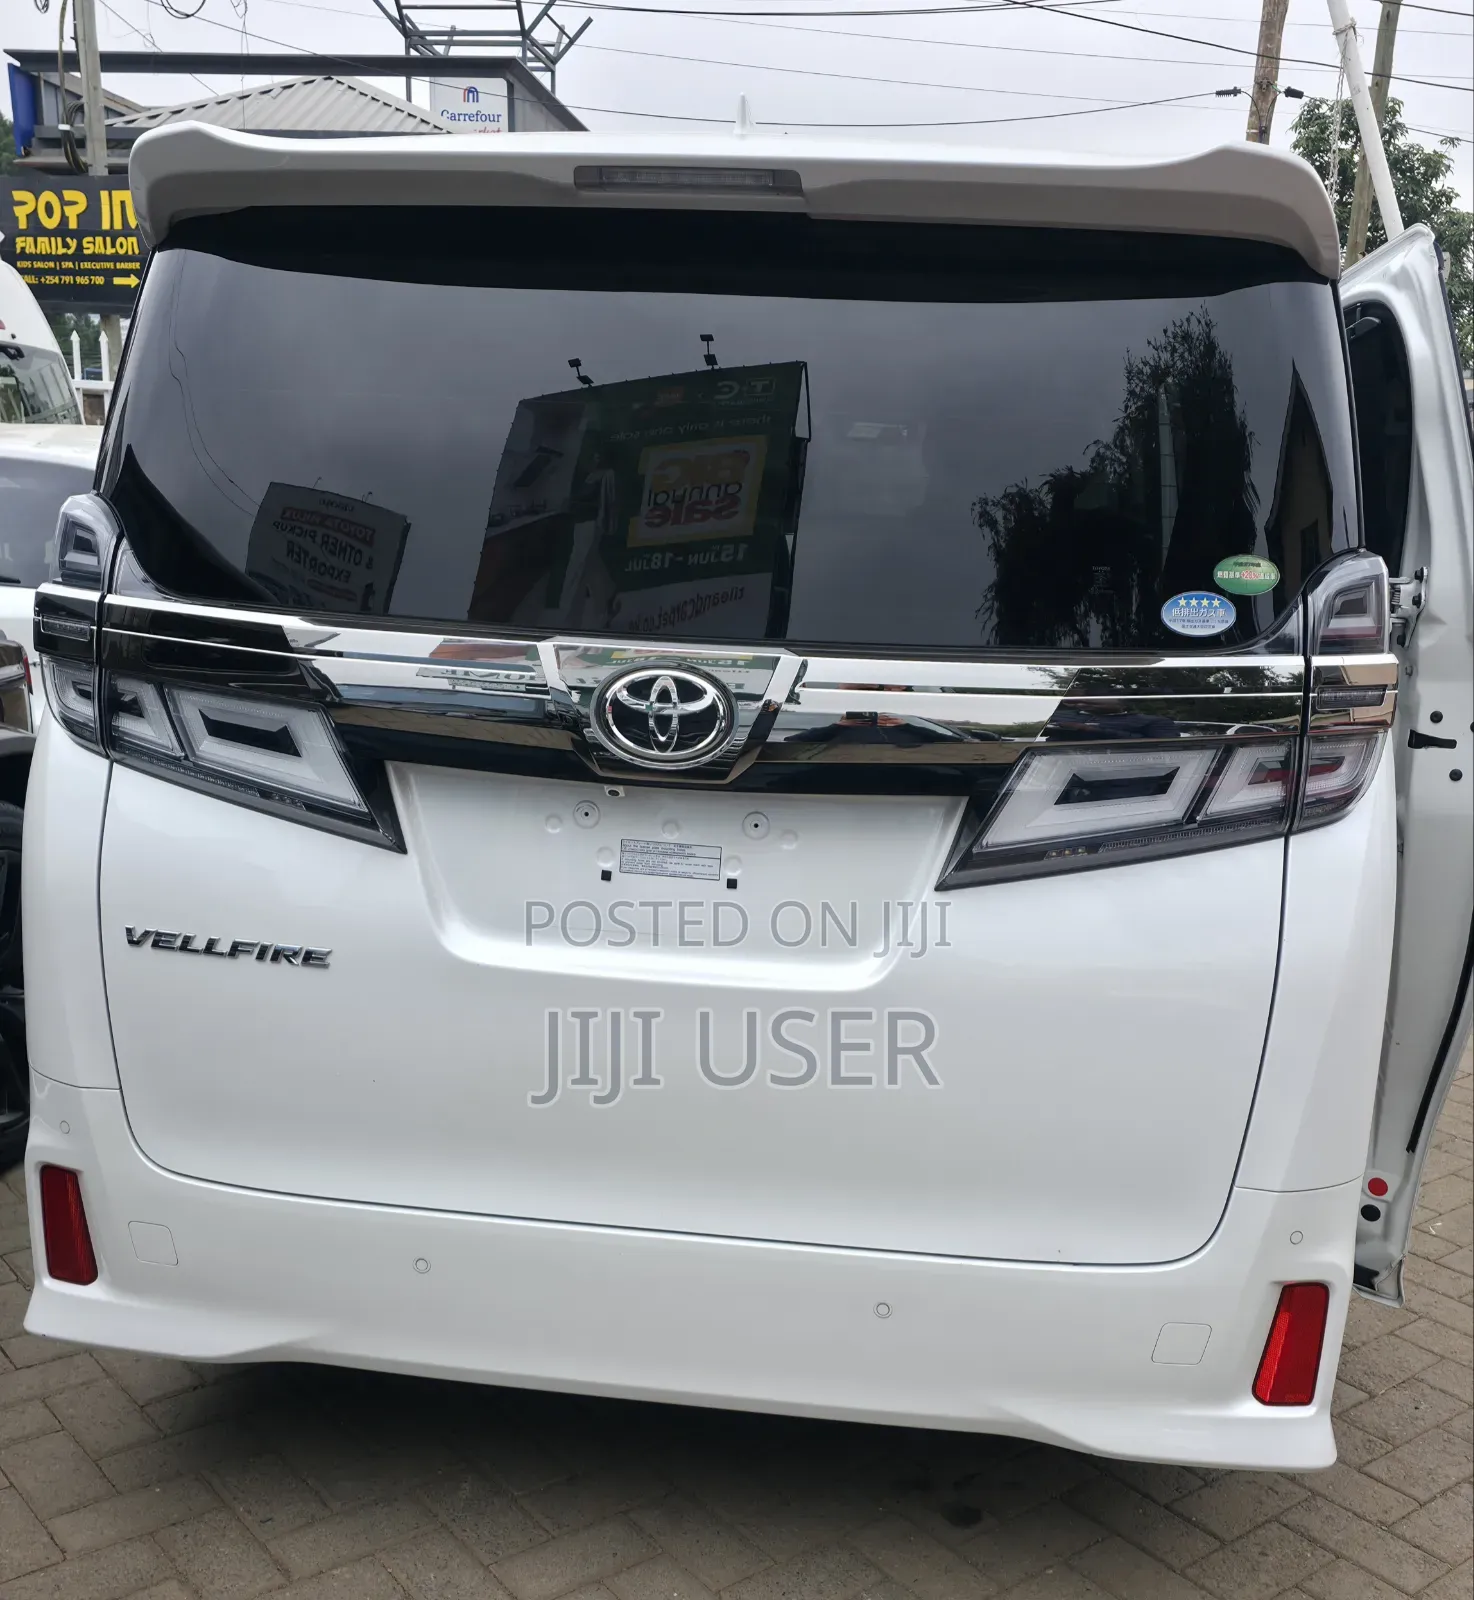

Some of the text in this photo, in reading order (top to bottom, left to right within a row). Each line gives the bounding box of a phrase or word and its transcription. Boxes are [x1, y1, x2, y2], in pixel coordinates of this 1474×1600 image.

[441, 109, 502, 123] Carrefour
[12, 190, 88, 229] POP
[16, 236, 140, 255] FAMILY SALON
[16, 260, 32, 269] KIDS
[33, 260, 55, 269] SALON
[61, 261, 74, 269] SPA
[80, 262, 115, 270] EXECUTIVE
[40, 276, 60, 284] +254
[60, 276, 74, 285] 791
[75, 276, 90, 285] 965
[90, 276, 105, 285] 700
[1172, 607, 1227, 618] 低排出ガス車
[125, 924, 333, 969] VELLFIRE
